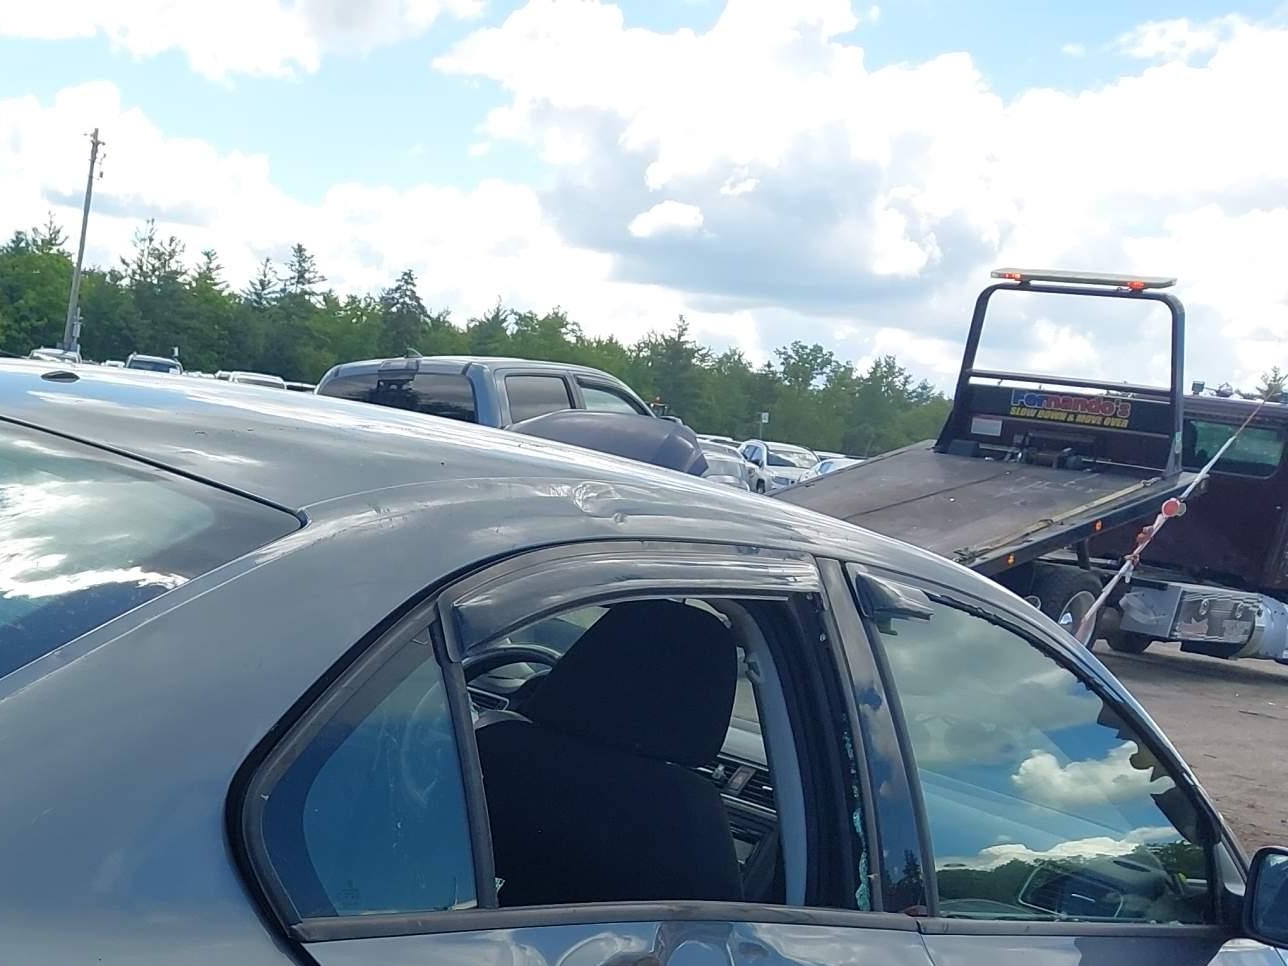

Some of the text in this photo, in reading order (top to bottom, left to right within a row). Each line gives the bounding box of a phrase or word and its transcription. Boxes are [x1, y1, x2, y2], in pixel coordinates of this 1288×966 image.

[1010, 407, 1037, 417] SLOW
[1037, 410, 1067, 421] DOWN
[1075, 413, 1104, 425] MOVE
[1103, 417, 1129, 428] OVER
